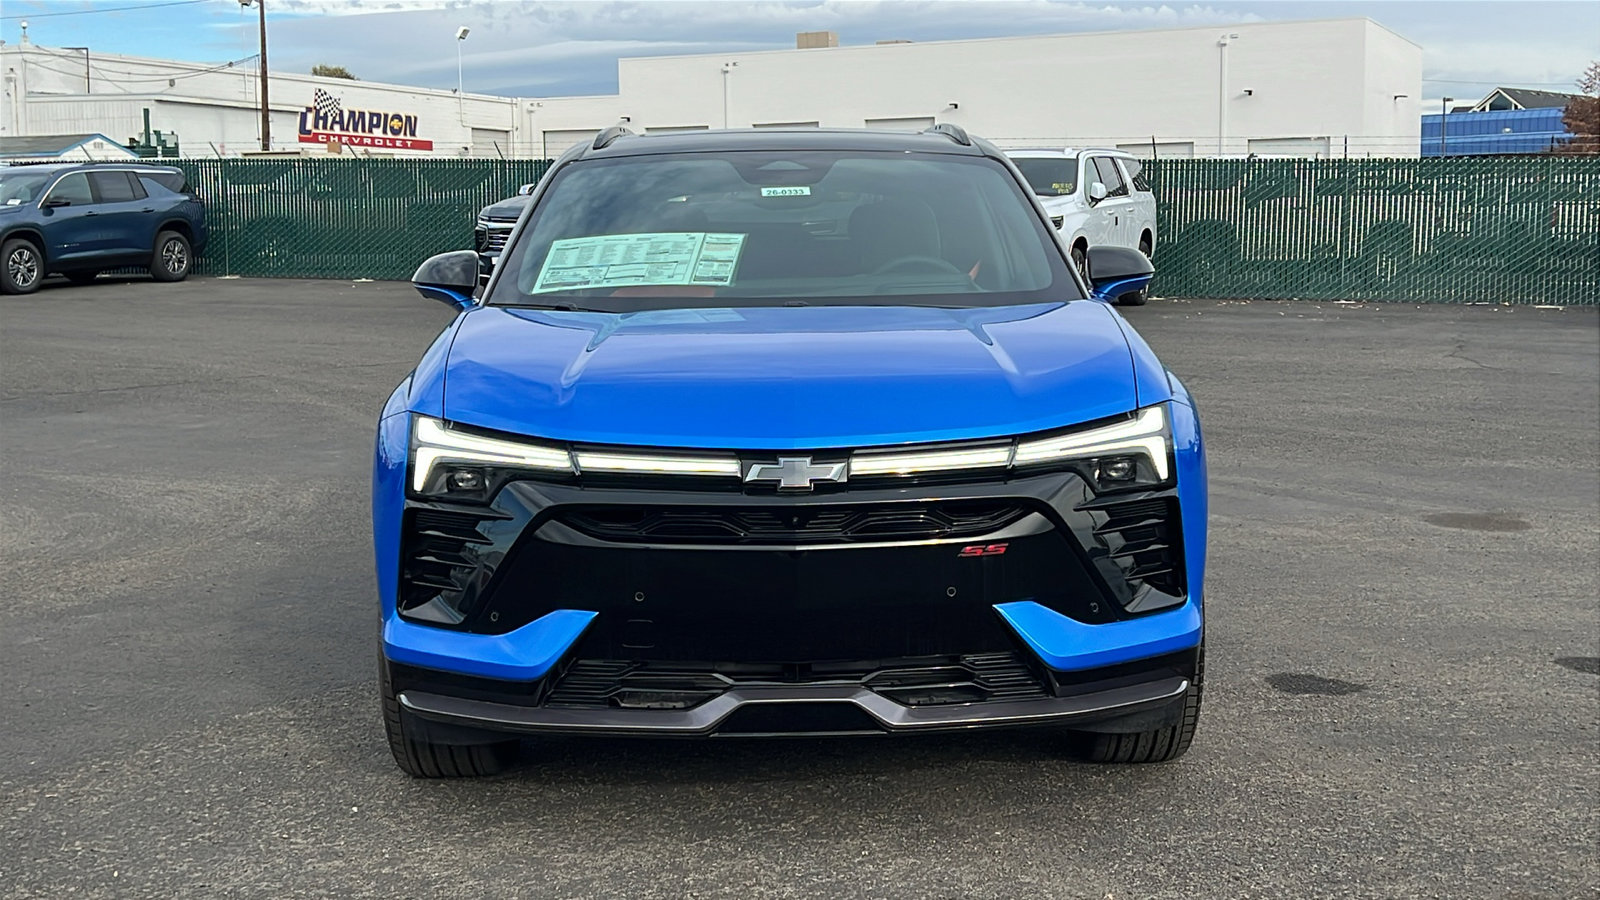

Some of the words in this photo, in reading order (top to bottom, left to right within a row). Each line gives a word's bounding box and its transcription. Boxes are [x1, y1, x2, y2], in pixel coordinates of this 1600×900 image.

[299, 106, 418, 137] CHAMPION
[318, 134, 413, 148] CHEVROLET
[766, 188, 805, 196] 26-0333
[957, 543, 1009, 557] SS
